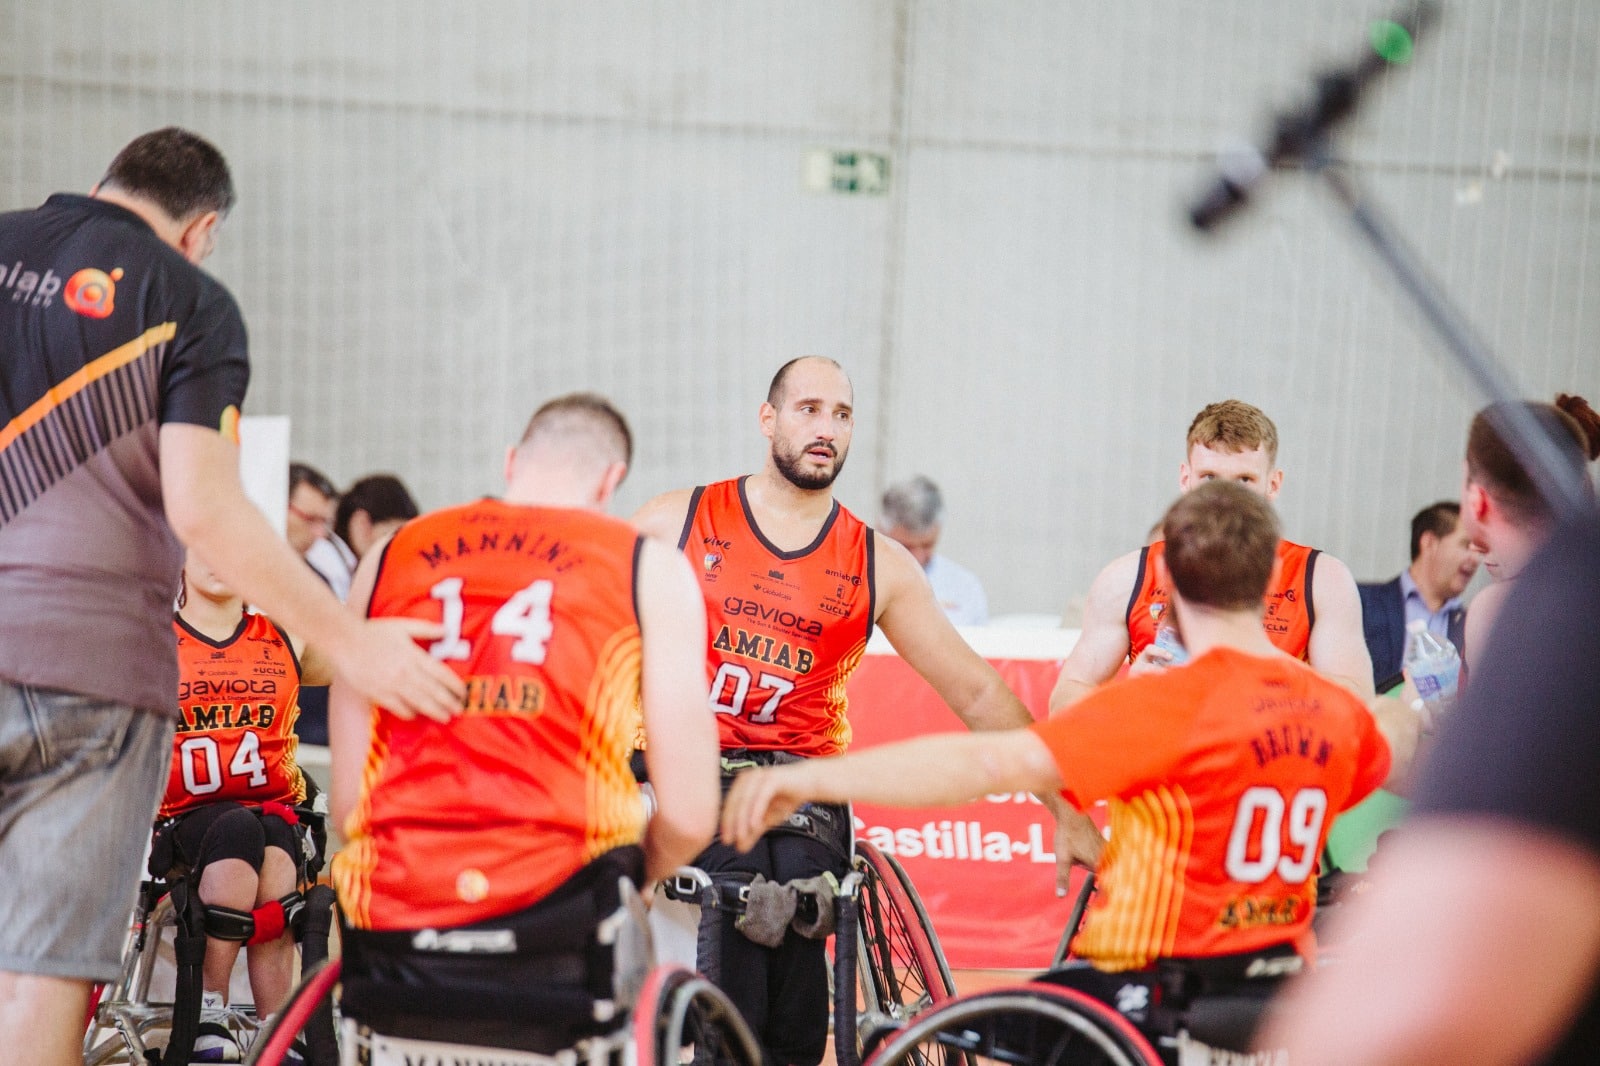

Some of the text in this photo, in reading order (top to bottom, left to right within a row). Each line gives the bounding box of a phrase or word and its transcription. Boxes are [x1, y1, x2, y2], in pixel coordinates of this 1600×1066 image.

[429, 577, 554, 666] 14
[724, 596, 823, 637] gaviota
[713, 624, 815, 675] AMIAB
[178, 679, 277, 701] gaviota
[709, 661, 796, 724] 07
[178, 730, 269, 797] 04
[1224, 785, 1328, 884] 09
